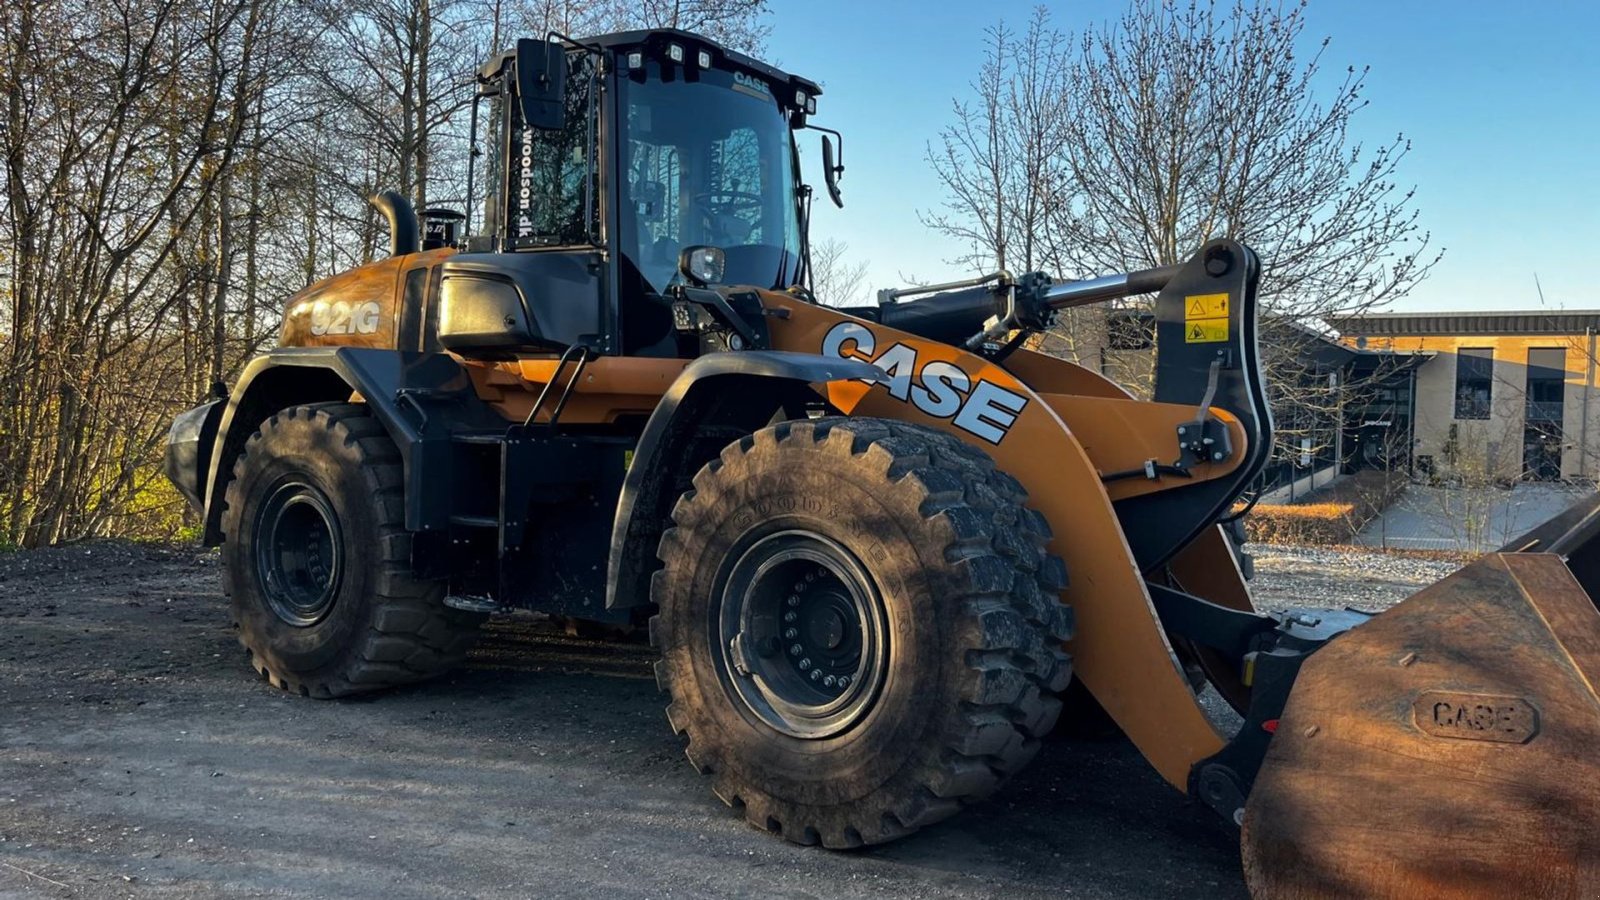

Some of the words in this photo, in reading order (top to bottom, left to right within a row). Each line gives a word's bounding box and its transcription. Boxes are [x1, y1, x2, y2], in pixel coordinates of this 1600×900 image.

[733, 71, 769, 95] CASE
[311, 301, 380, 336] 921G
[821, 321, 1030, 446] CASE
[1433, 702, 1516, 732] CASE
